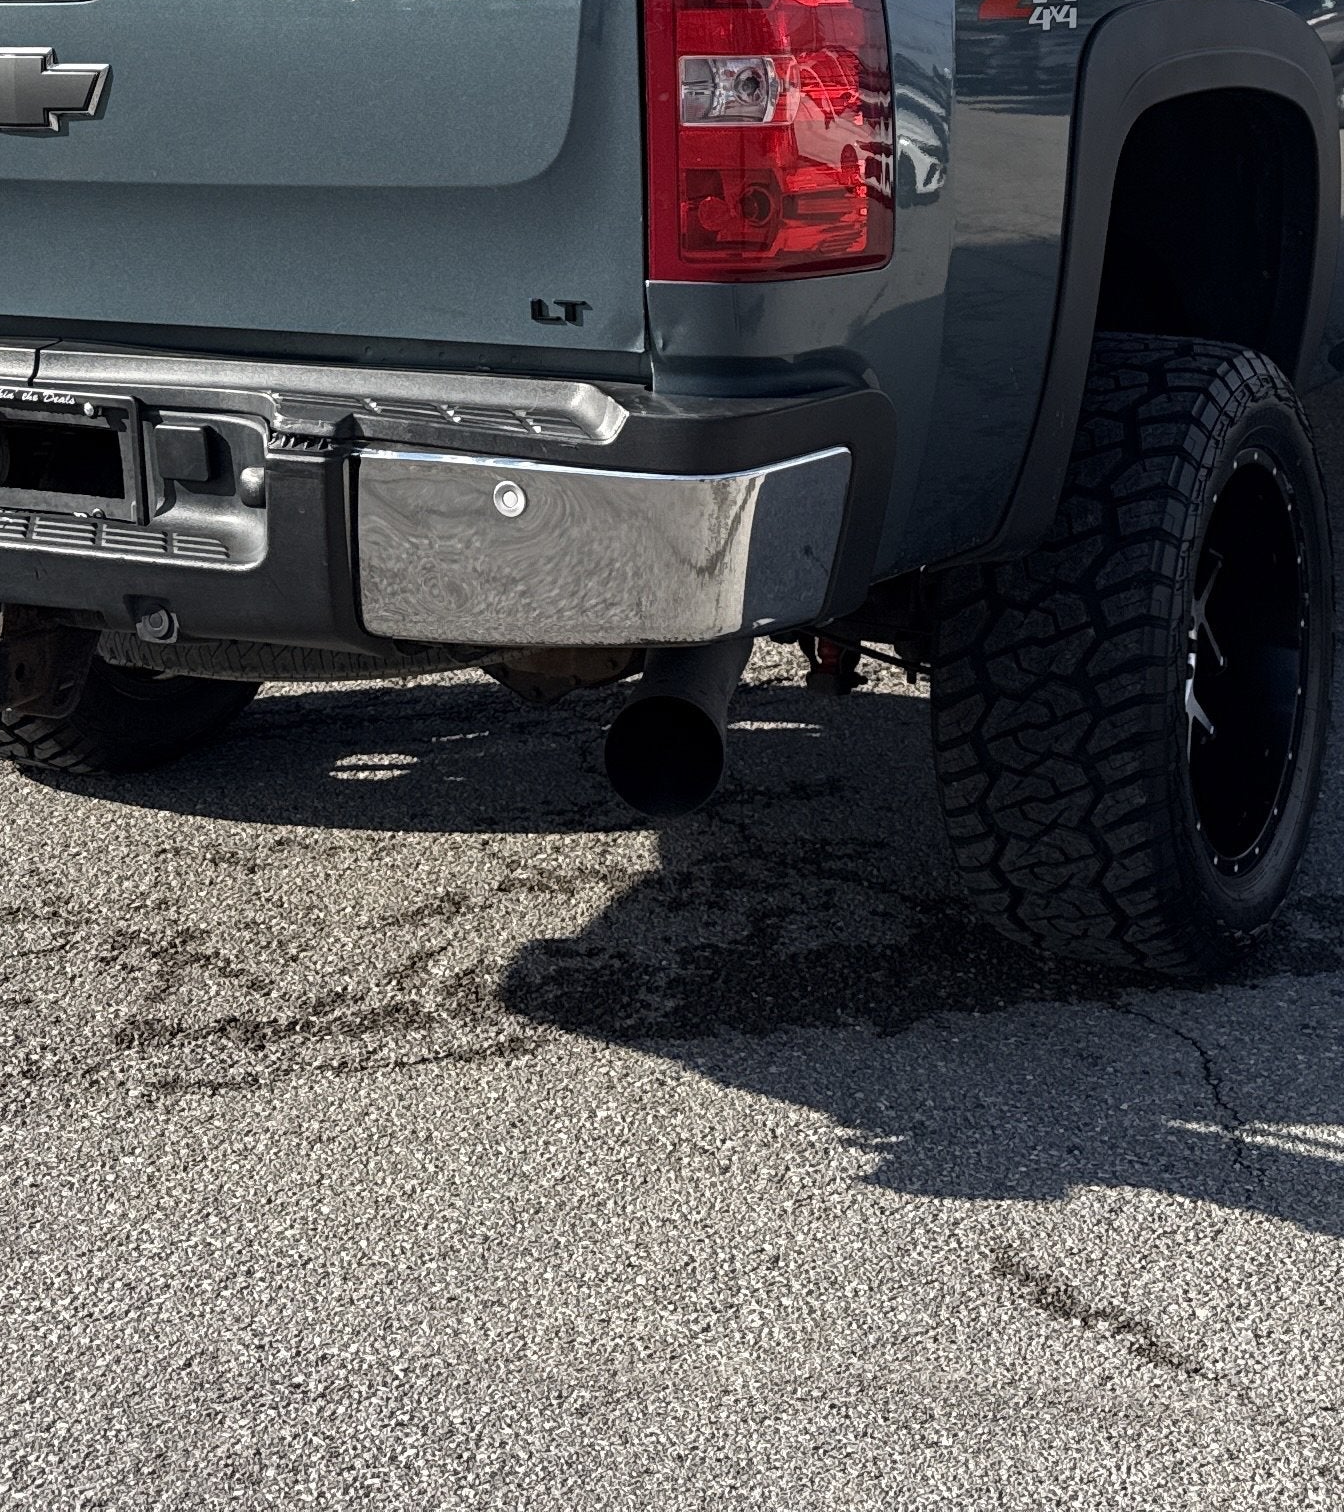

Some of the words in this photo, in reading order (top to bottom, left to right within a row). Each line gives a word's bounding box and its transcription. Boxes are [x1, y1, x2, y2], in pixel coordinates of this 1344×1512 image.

[530, 298, 592, 327] LT
[21, 391, 39, 402] the
[42, 392, 76, 405] Deals
